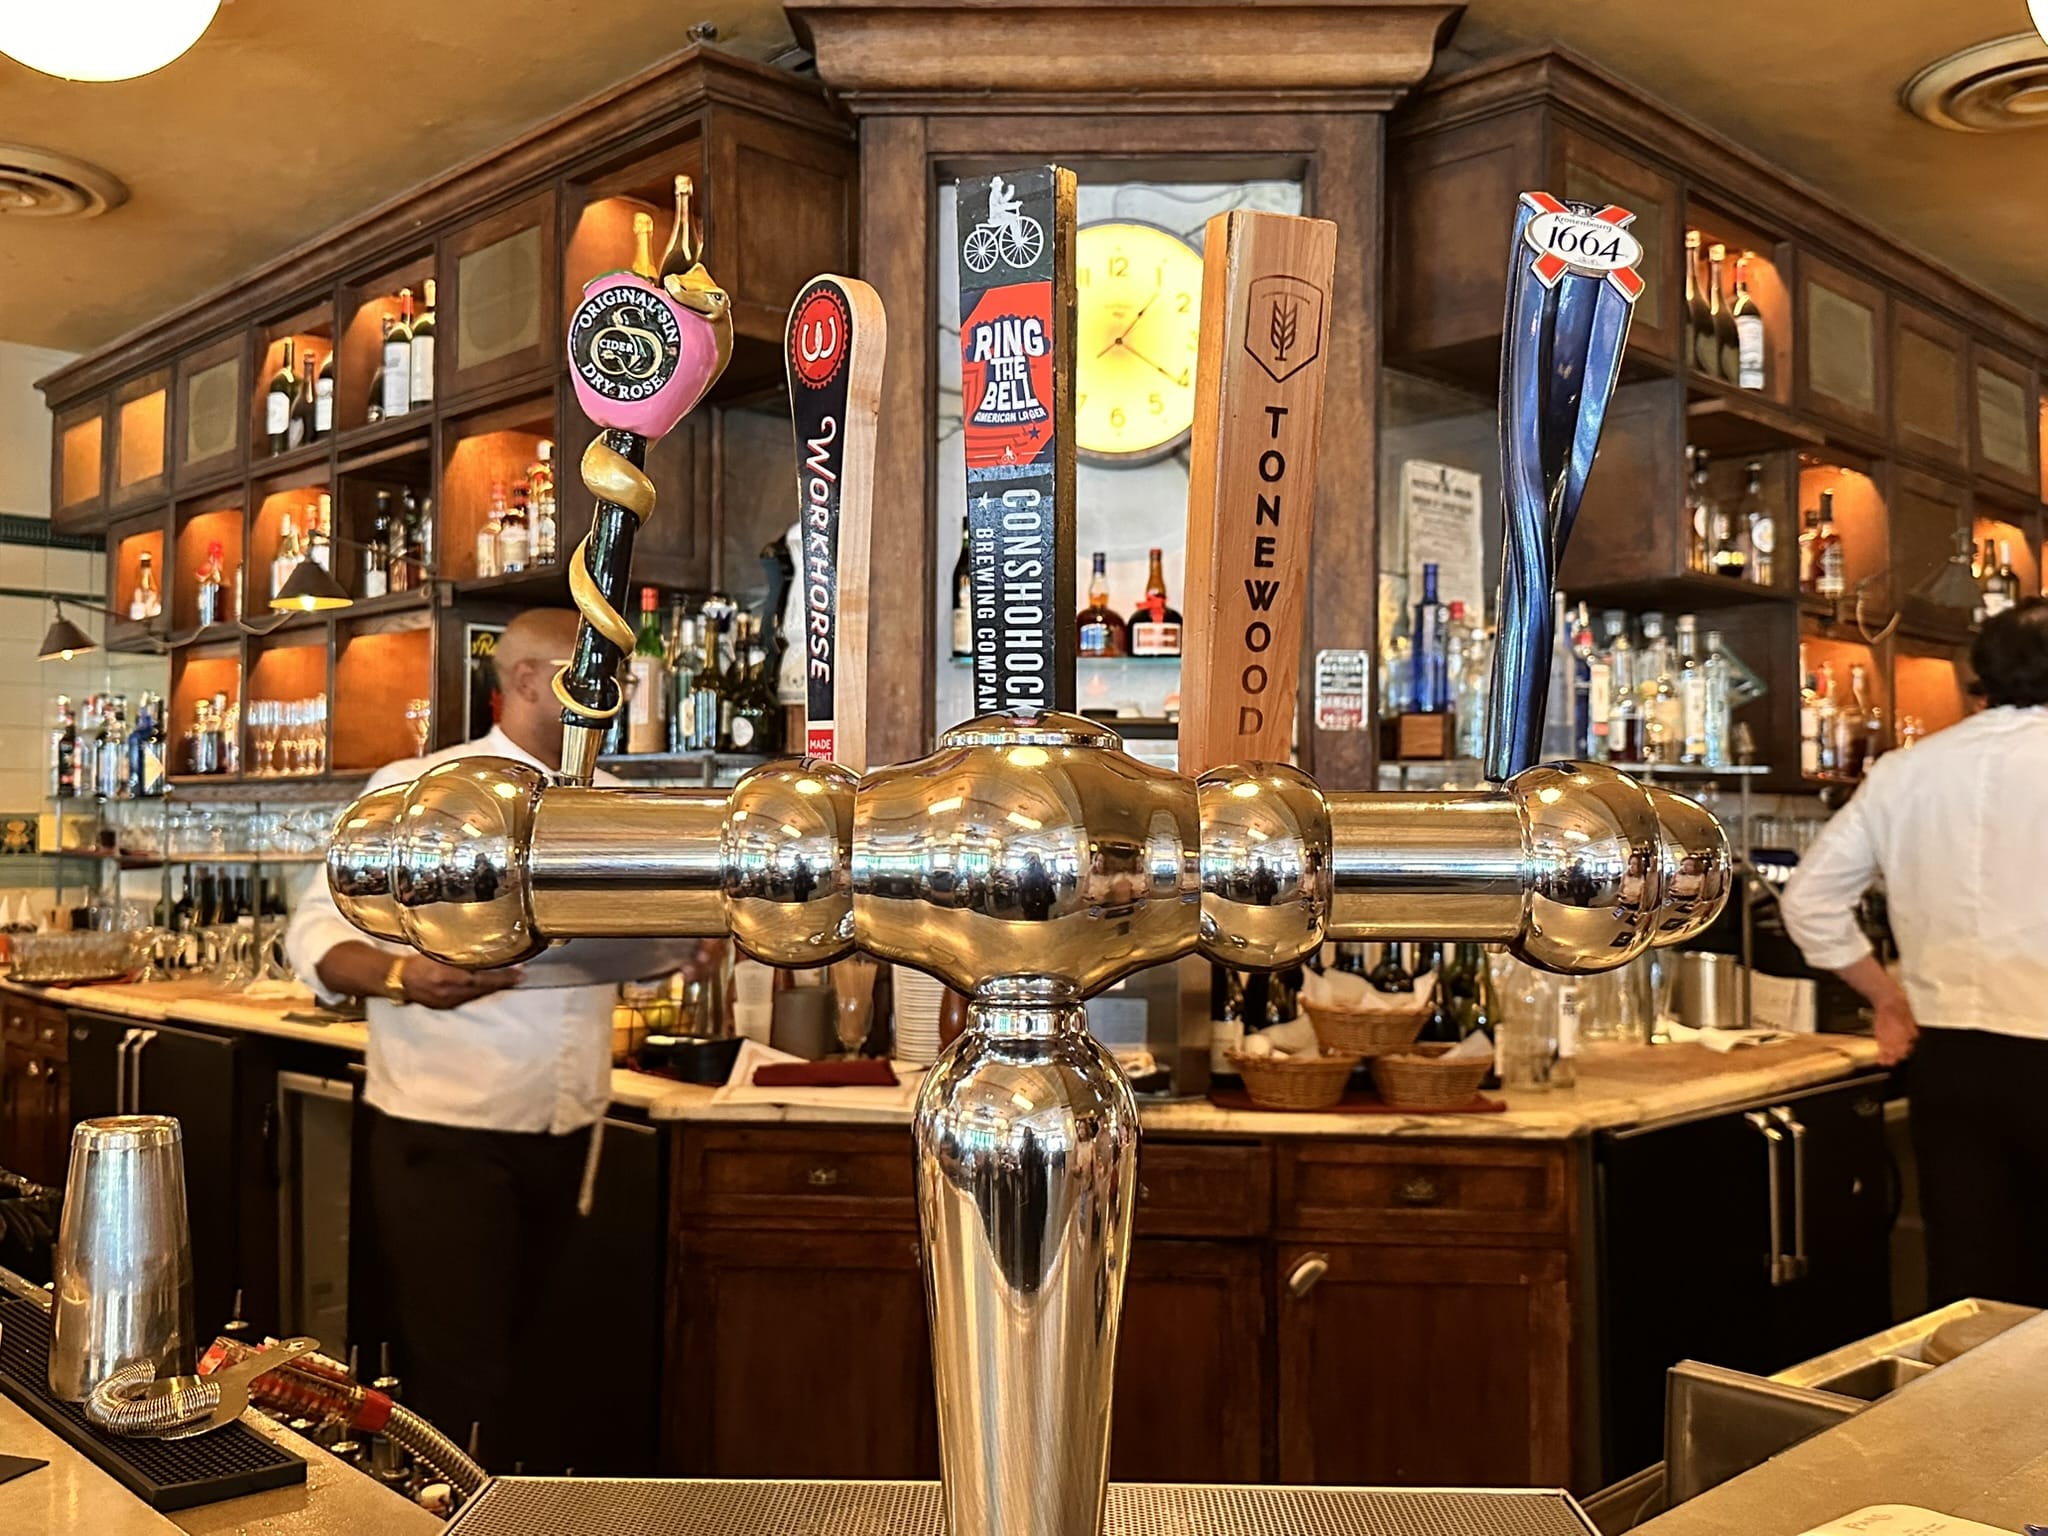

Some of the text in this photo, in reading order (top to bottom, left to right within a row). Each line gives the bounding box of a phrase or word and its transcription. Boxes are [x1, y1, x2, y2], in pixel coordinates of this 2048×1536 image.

[1548, 226, 1628, 262] 1664
[1108, 257, 1129, 277] 12
[1176, 293, 1191, 313] 2
[579, 289, 680, 344] ORIGINAL SIN
[599, 339, 634, 353] CIDER
[974, 319, 1044, 363] RING
[581, 362, 615, 394] DRY
[990, 356, 1027, 382] THE
[1177, 368, 1190, 388] 4
[980, 376, 1039, 411] BELL
[1149, 394, 1165, 415] 5
[974, 407, 1047, 424] AMERICAN LAGER
[1110, 408, 1126, 429] 6
[975, 528, 995, 619] BREWING
[1238, 406, 1288, 736] TONEWOOD
[809, 739, 832, 750] MADE
